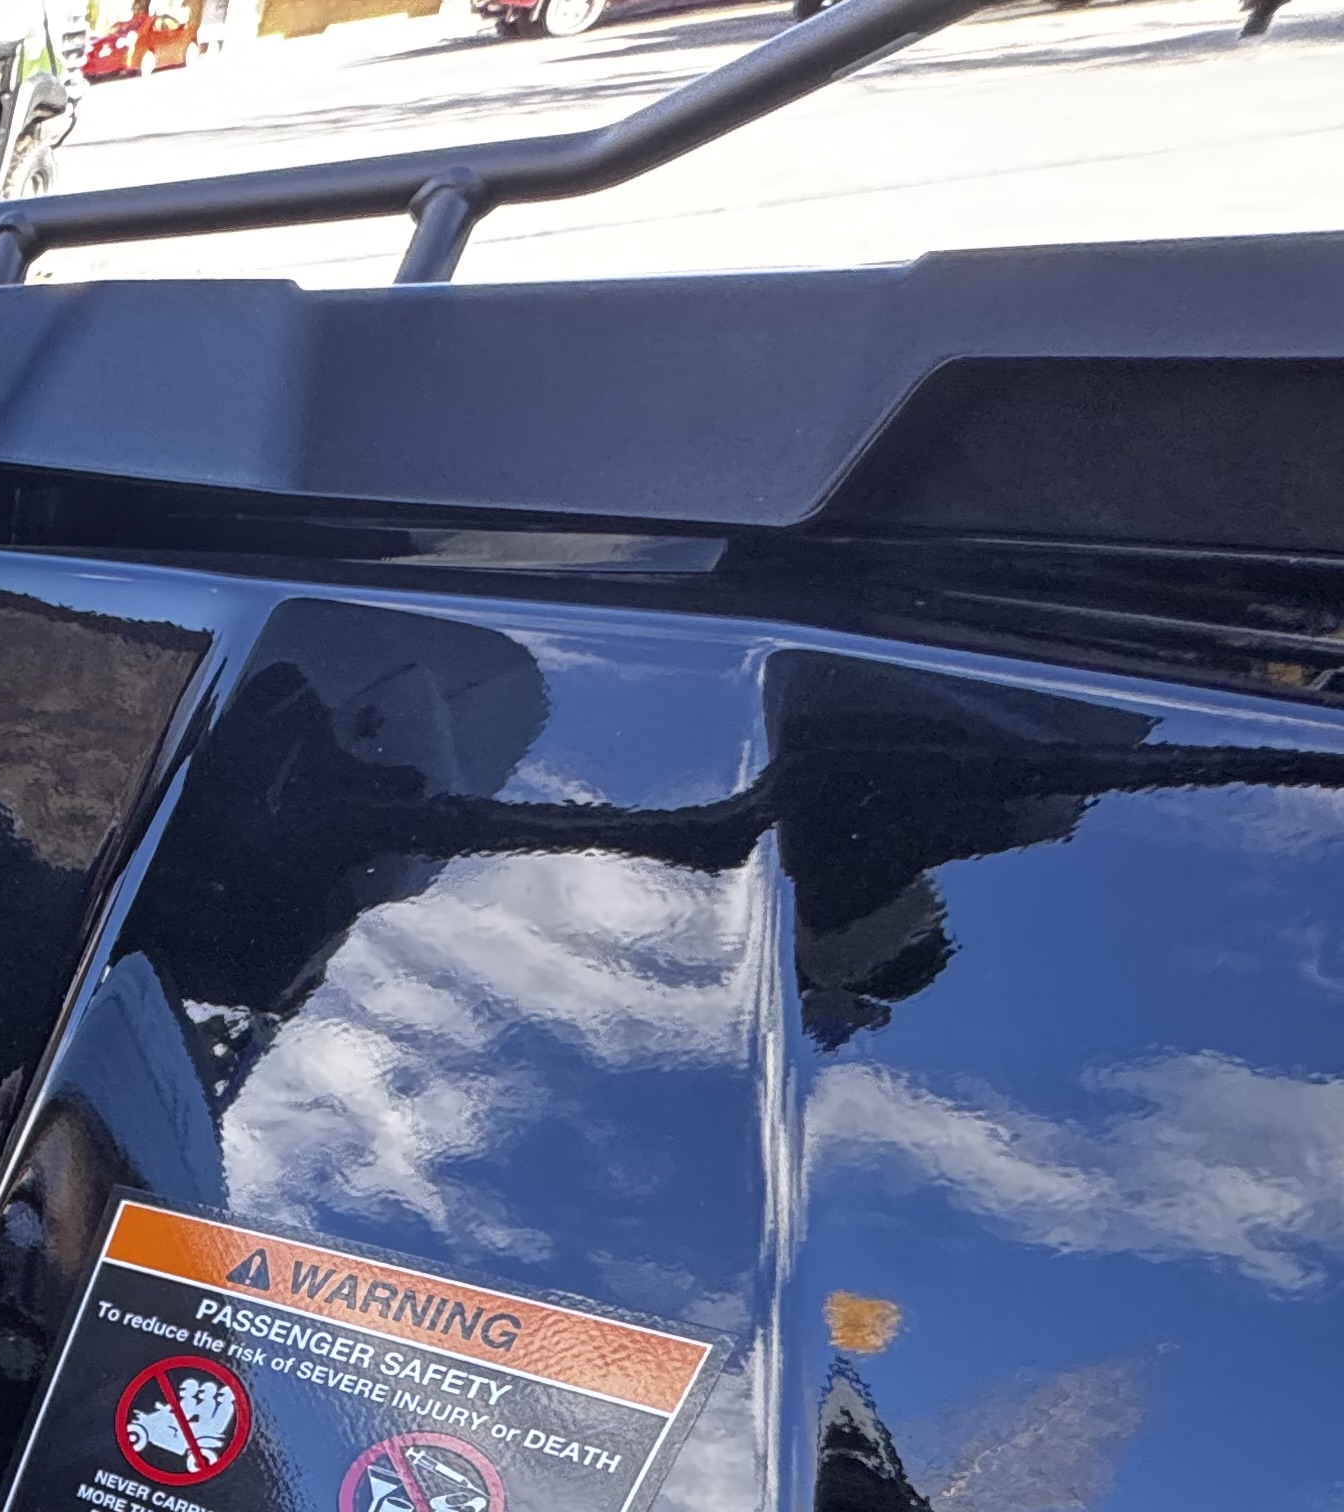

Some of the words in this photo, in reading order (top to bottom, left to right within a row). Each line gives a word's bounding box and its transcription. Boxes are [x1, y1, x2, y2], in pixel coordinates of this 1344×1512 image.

[195, 1298, 375, 1369] PASSENGER
[379, 1351, 513, 1406] SAFETY
[290, 1260, 522, 1353] WARNING
[98, 1300, 121, 1322] To
[122, 1313, 190, 1342] reduce
[193, 1330, 226, 1353] the
[227, 1343, 268, 1366] risk
[270, 1357, 297, 1374] of
[296, 1361, 391, 1406] SEVERE
[391, 1389, 491, 1431] INJURY
[490, 1423, 522, 1442] or
[522, 1428, 622, 1474] DEATH
[94, 1469, 151, 1501] NEVER
